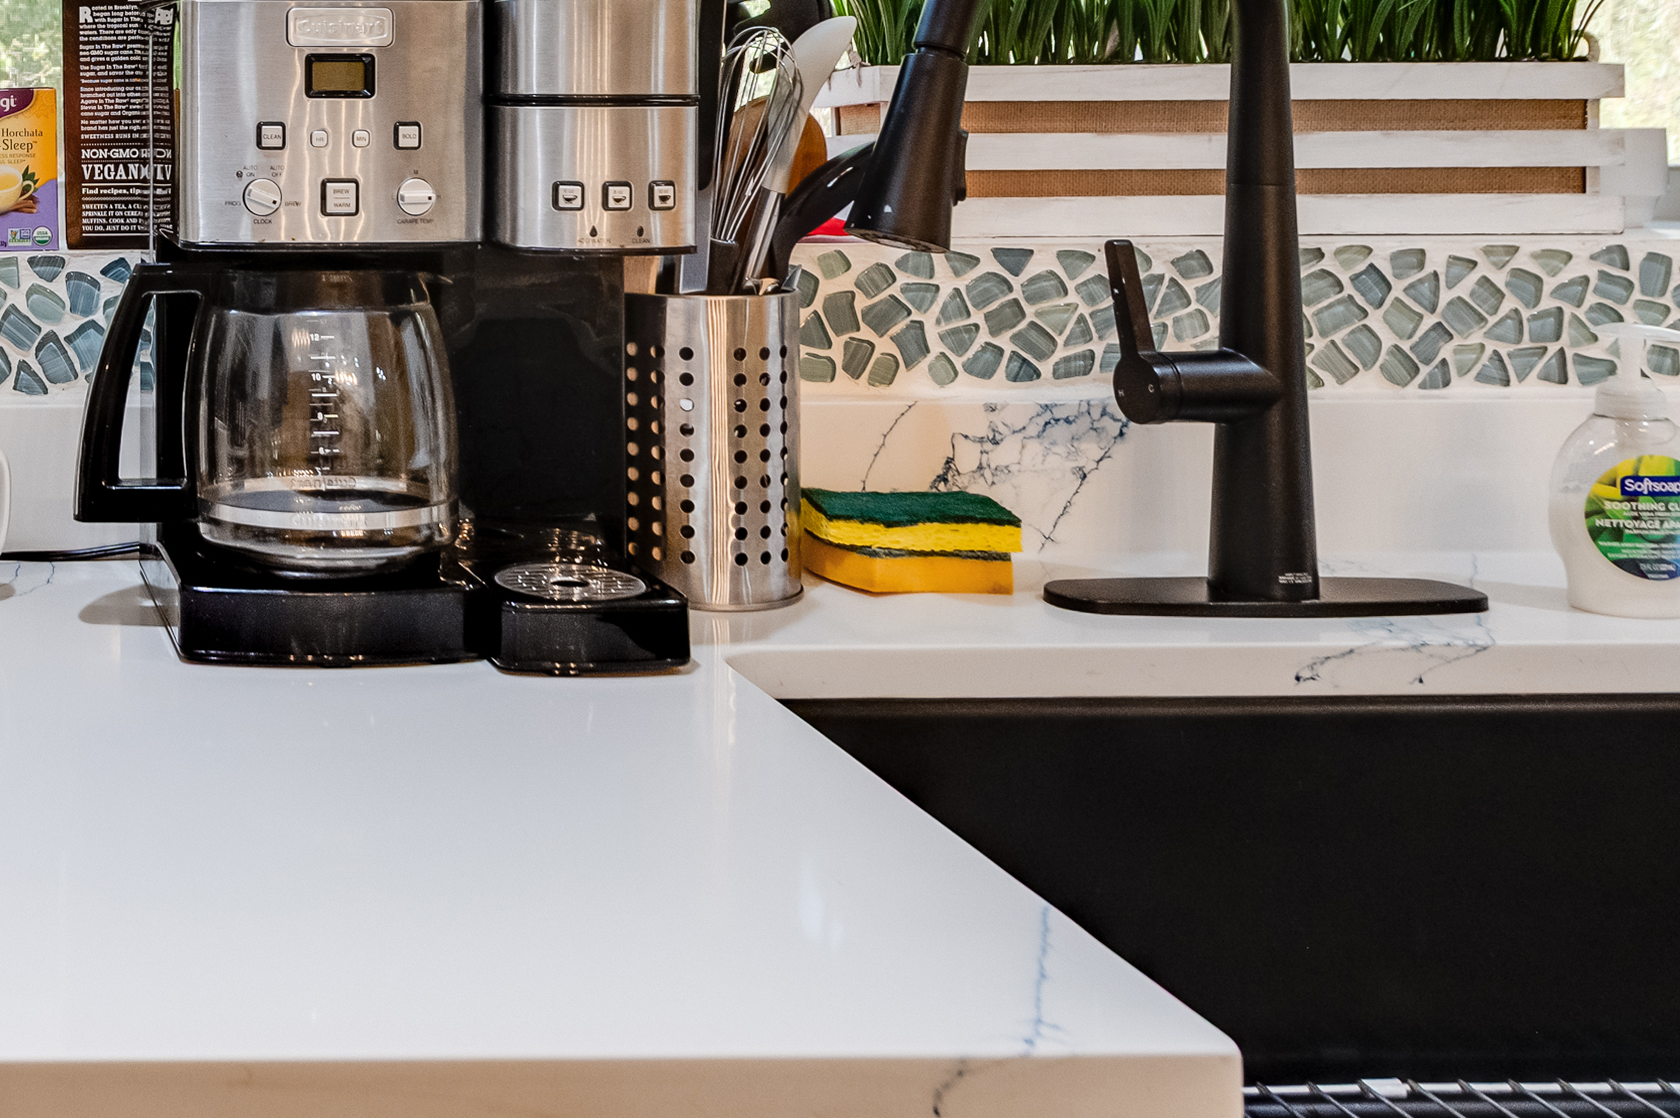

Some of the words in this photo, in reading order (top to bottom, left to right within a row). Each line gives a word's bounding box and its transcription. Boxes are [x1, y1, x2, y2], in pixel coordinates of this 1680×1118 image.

[1, 128, 43, 137] Horchata
[81, 148, 139, 159] NON-GMO
[81, 164, 140, 180] VEGAN
[311, 373, 321, 381] 10
[1603, 501, 1666, 511] SOOTHING
[1595, 519, 1660, 529] NETTOYAGE
